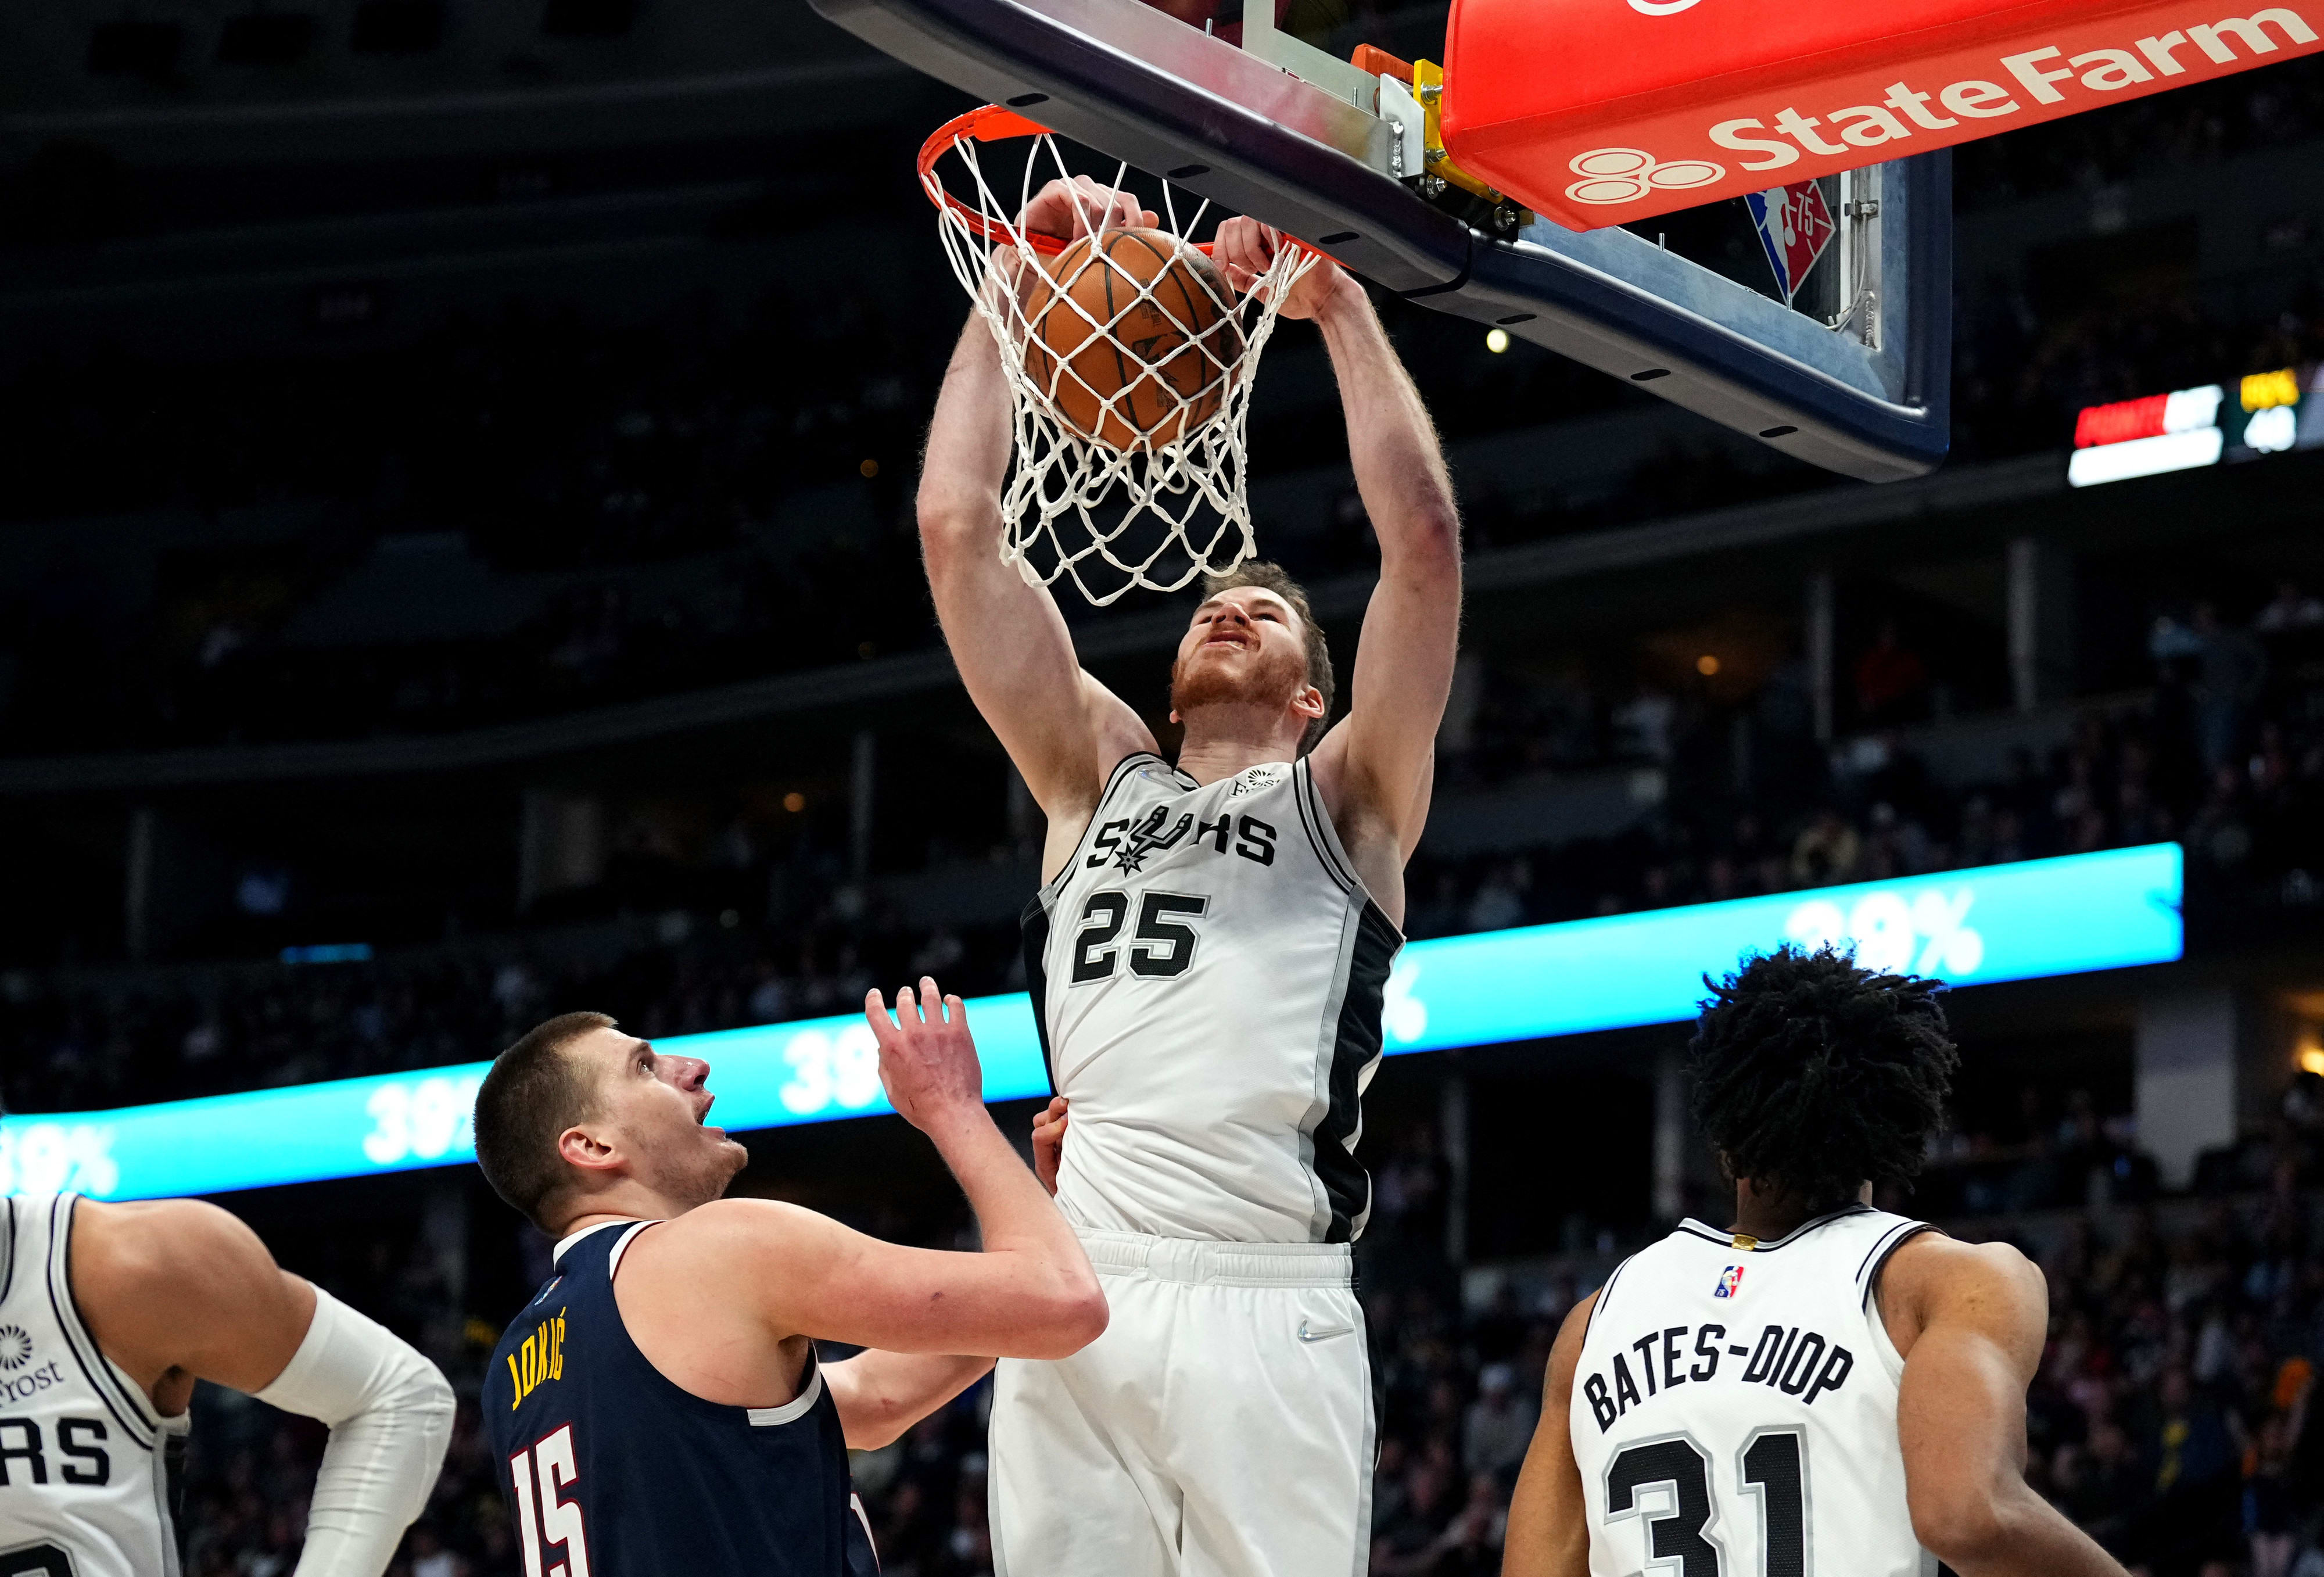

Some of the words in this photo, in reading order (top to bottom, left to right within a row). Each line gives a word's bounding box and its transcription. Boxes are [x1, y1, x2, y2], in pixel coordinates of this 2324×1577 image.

[1069, 888, 1211, 988] 25
[0, 1360, 64, 1408] rost
[507, 1307, 566, 1411] JOKIĆ
[1584, 1324, 1854, 1435] BATES-DIOP
[508, 1420, 590, 1577] 15
[1601, 1423, 1814, 1577] 31
